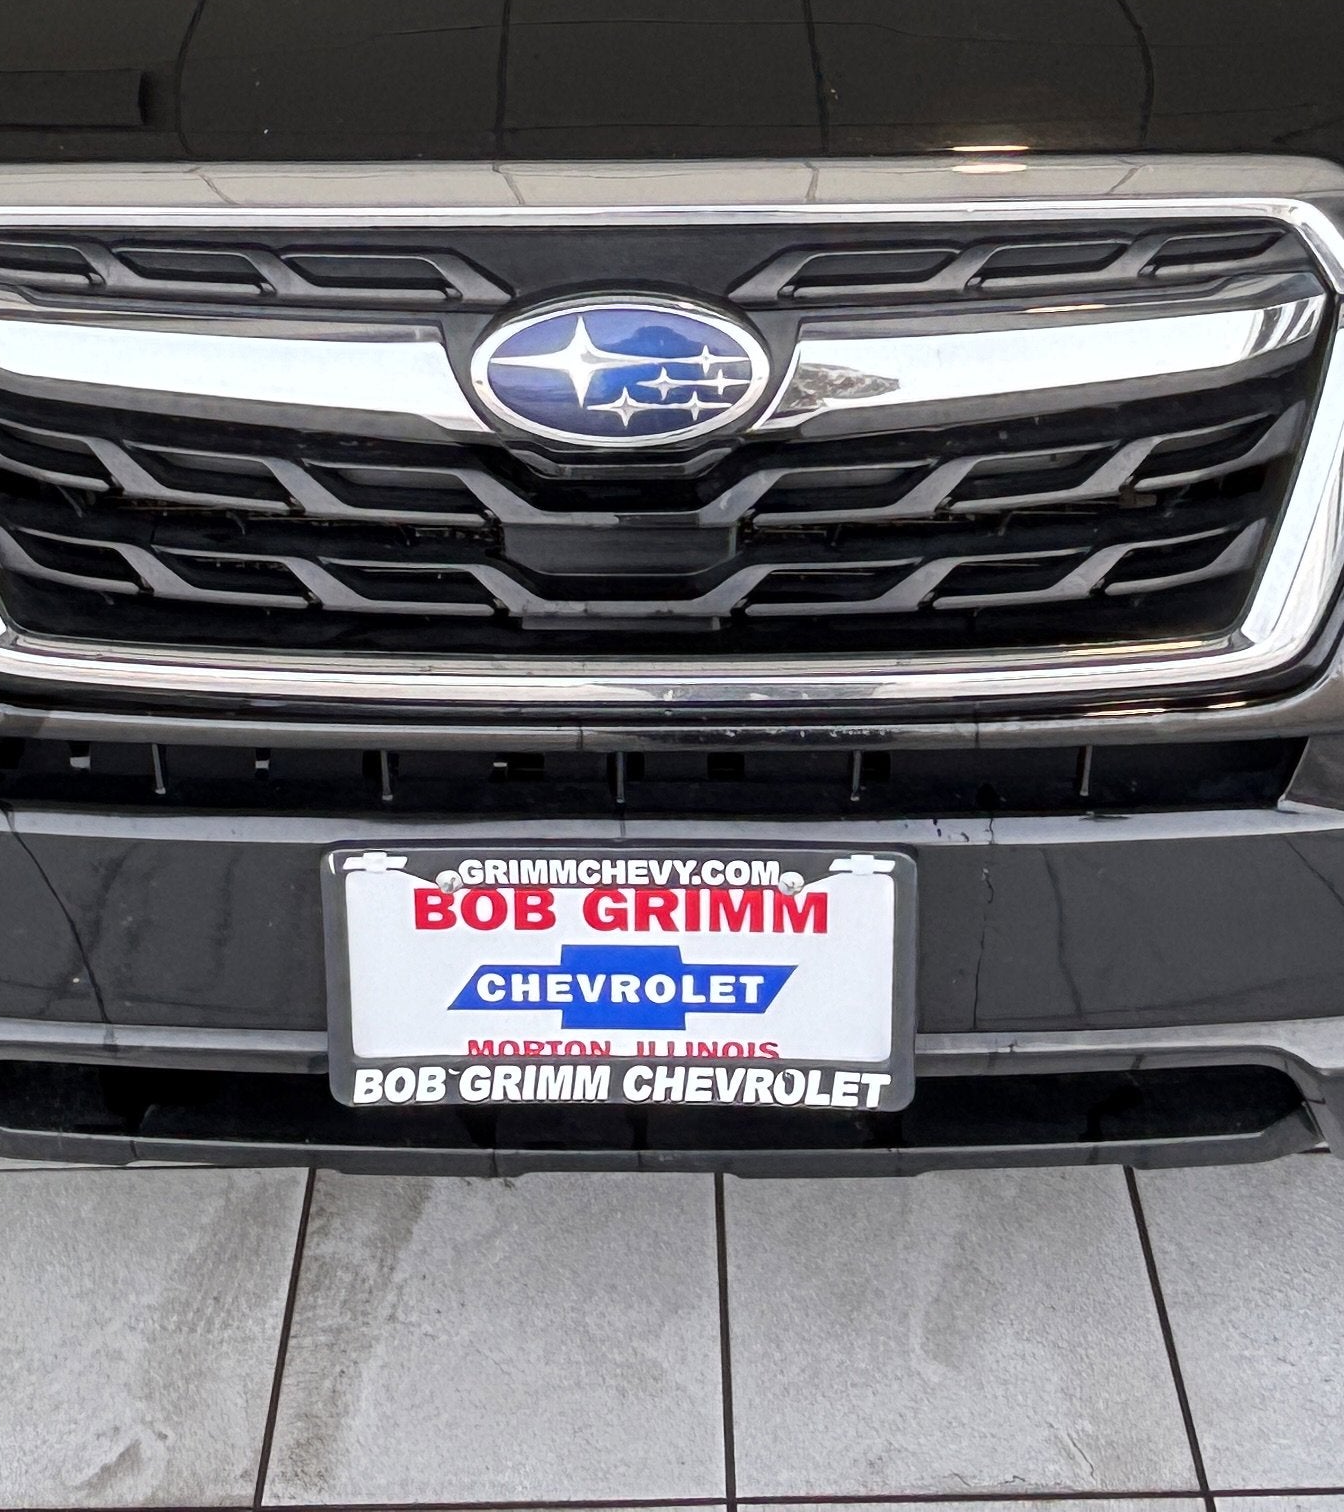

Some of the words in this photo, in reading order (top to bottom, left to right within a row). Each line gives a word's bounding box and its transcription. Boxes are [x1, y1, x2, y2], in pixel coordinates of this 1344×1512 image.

[459, 859, 780, 886] GRIMMCHEVY.COM
[414, 887, 556, 931] BOB
[583, 887, 829, 934] GRIMM
[476, 973, 765, 1005] CHEVROLET
[353, 1067, 447, 1104] BOB
[459, 1066, 609, 1103] GRIMM
[623, 1068, 892, 1109] CHEVROLET
